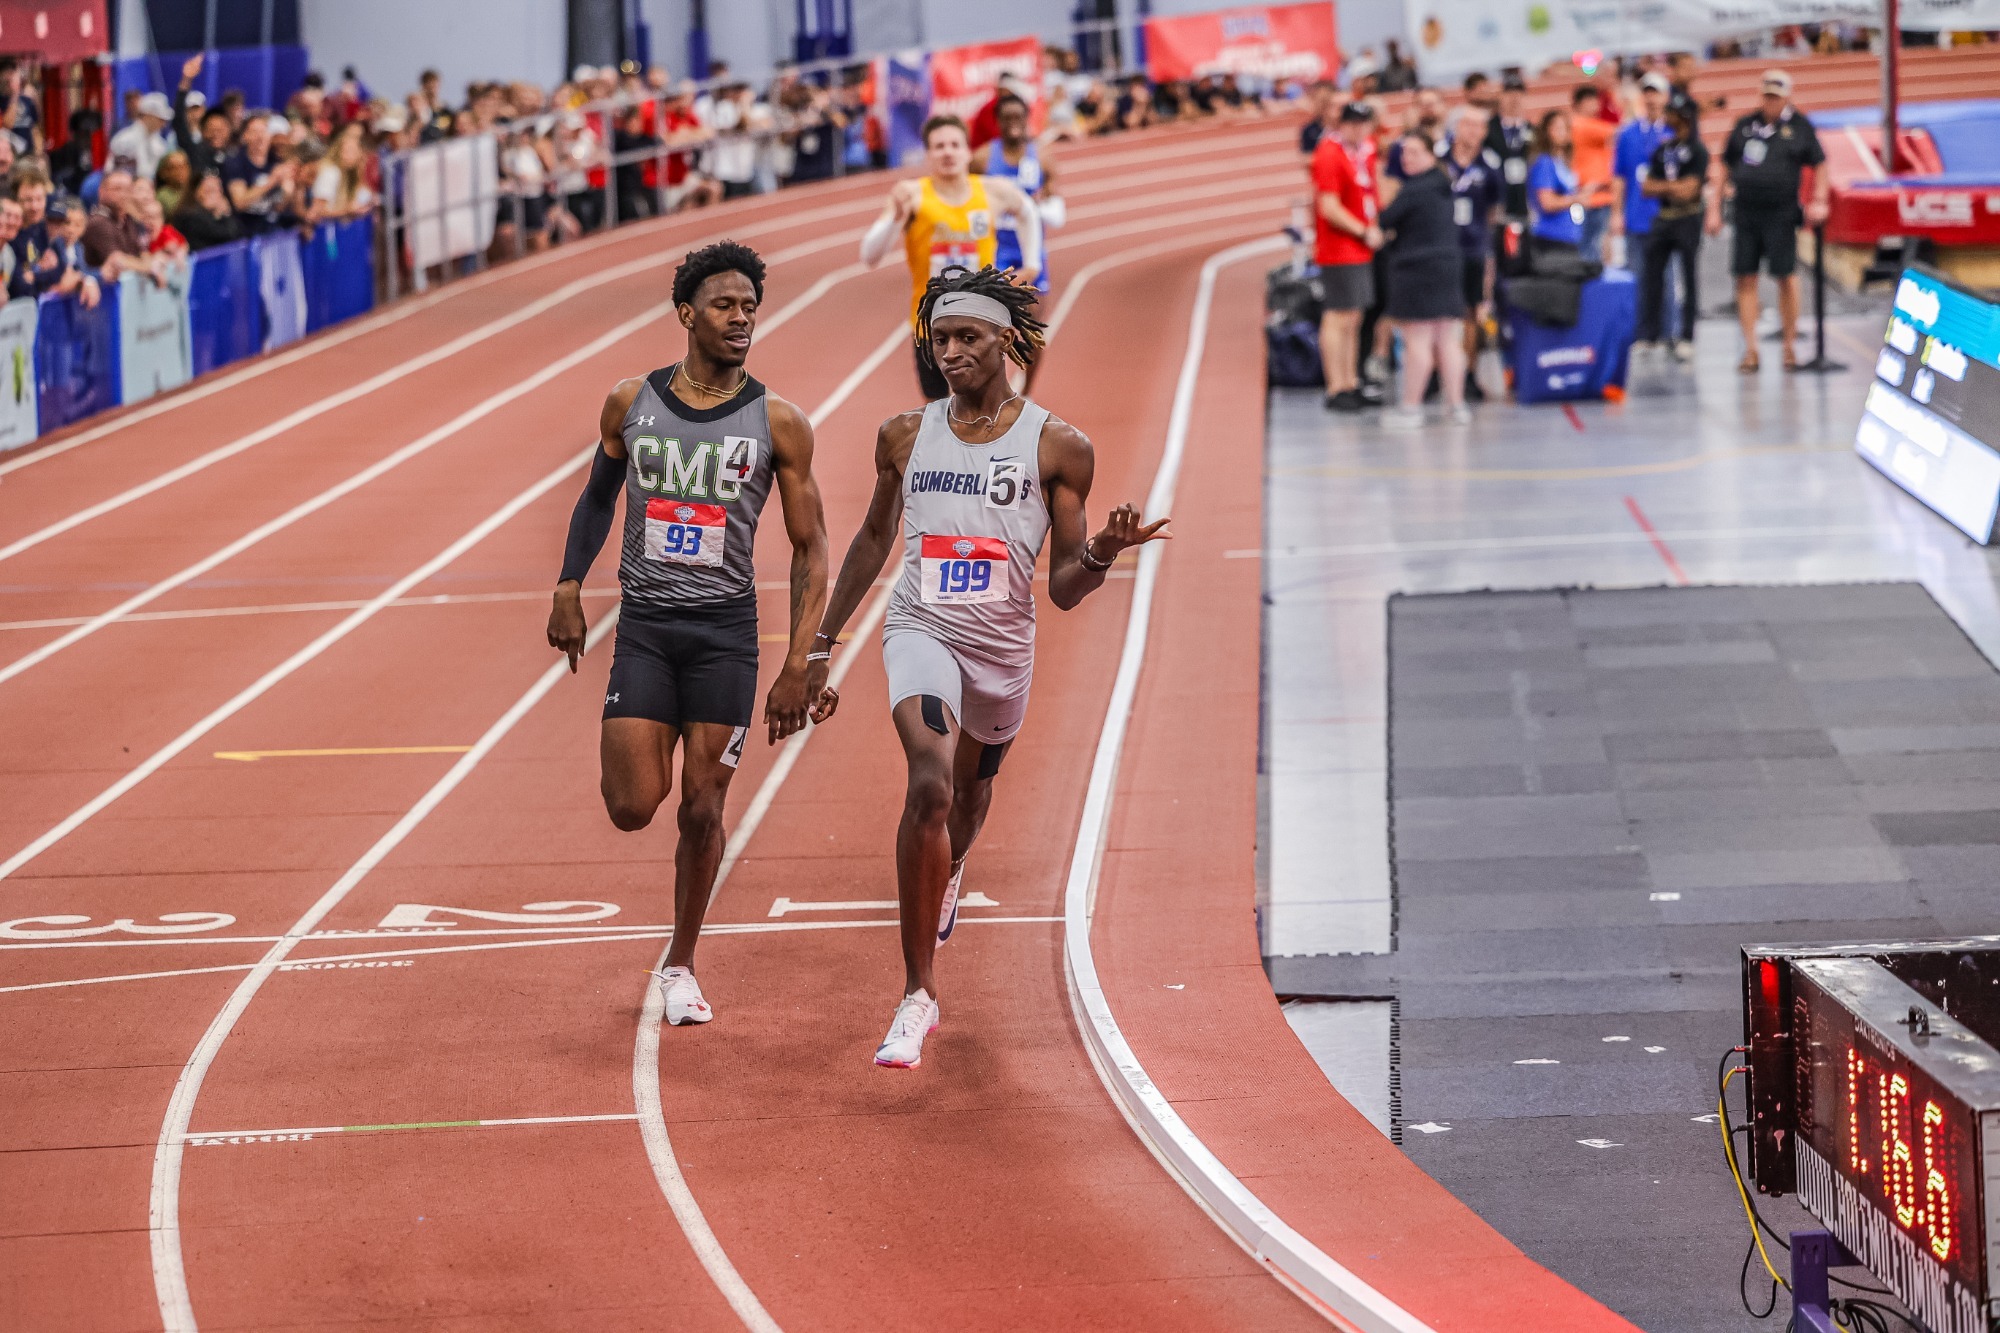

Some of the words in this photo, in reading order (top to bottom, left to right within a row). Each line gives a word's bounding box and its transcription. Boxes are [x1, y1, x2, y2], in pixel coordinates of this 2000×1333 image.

[725, 440, 750, 479] 4
[911, 471, 1031, 501] CUMBERLS
[989, 464, 1017, 506] 5
[664, 523, 703, 556] 93
[938, 560, 992, 593] 199
[0, 912, 236, 940] 3
[378, 901, 621, 927] 2
